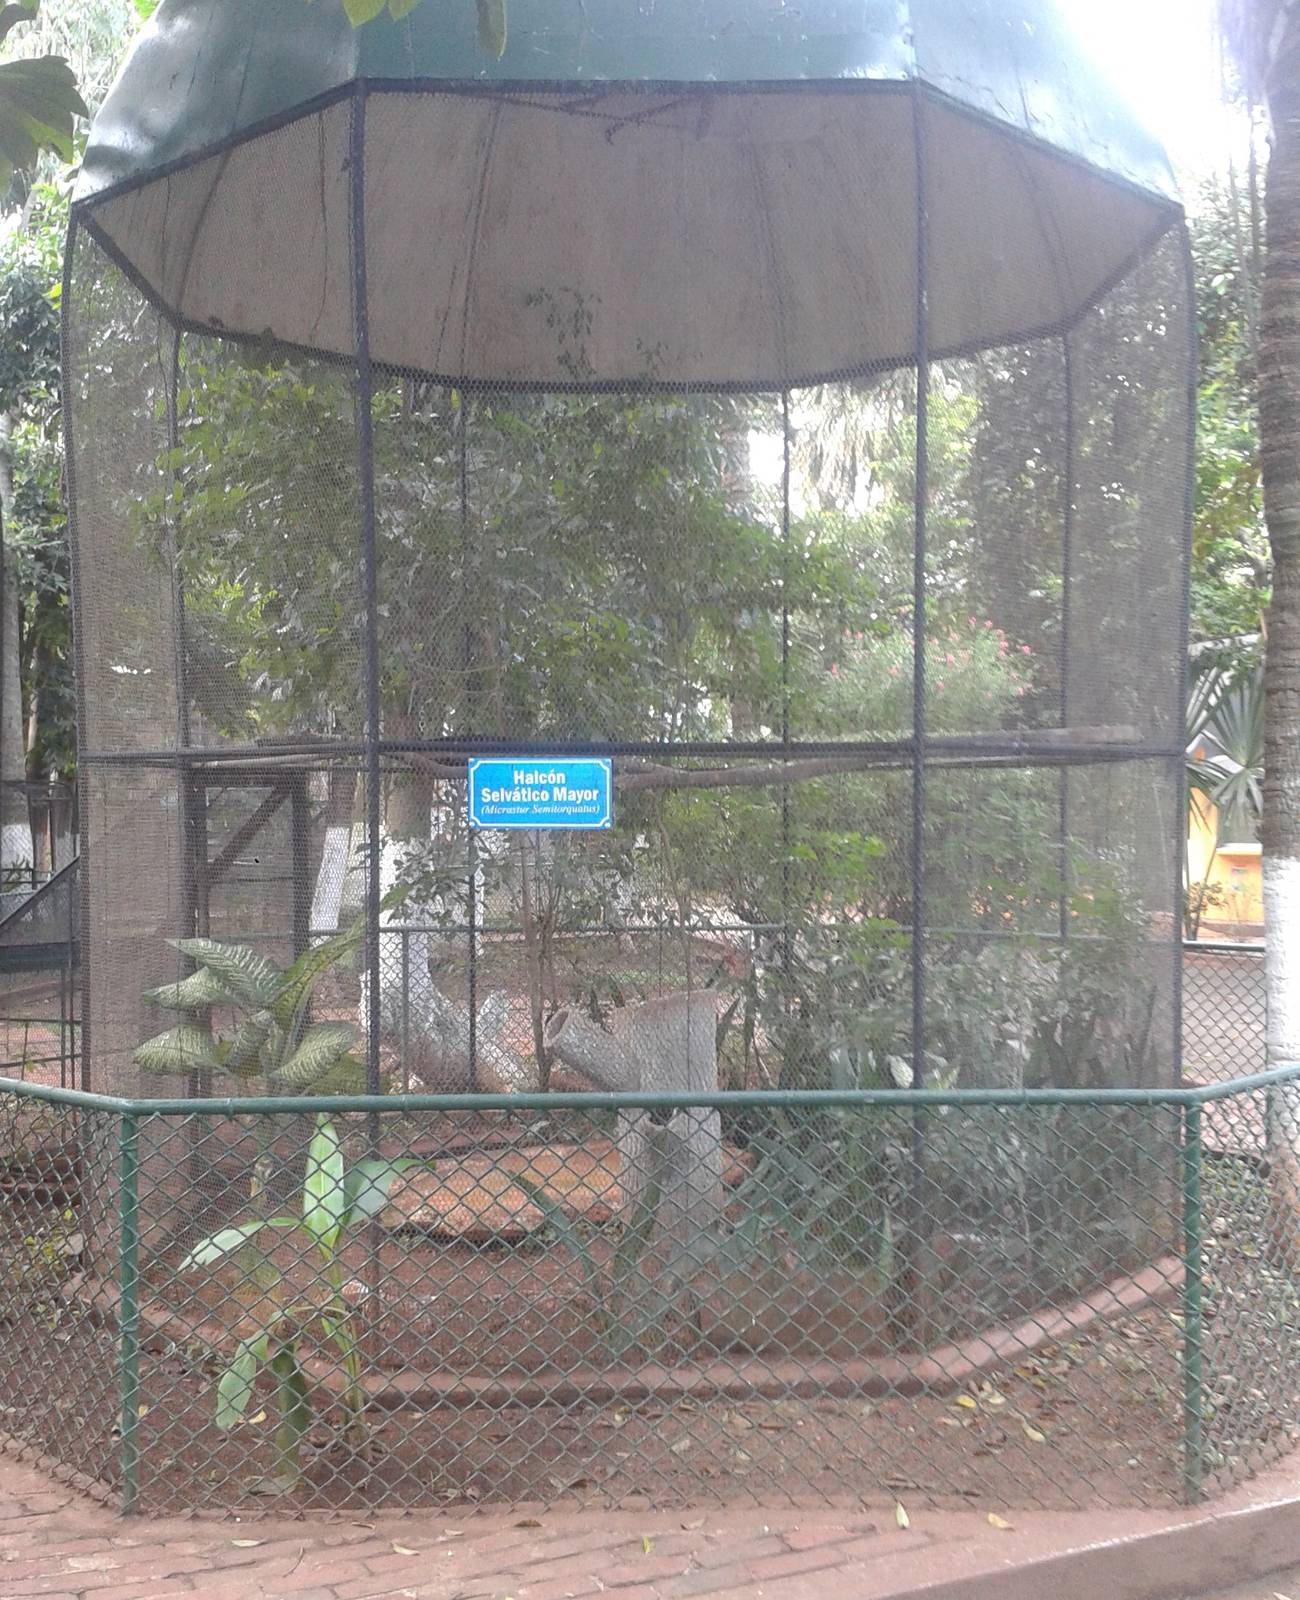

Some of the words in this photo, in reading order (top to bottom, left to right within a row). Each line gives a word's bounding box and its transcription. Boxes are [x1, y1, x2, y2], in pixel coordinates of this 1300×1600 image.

[513, 769, 566, 785] Halcón
[481, 787, 549, 803] Selvático
[553, 787, 599, 804] Mayor
[481, 805, 530, 815] (Micrastur
[531, 804, 600, 815] Semitorquatus)
